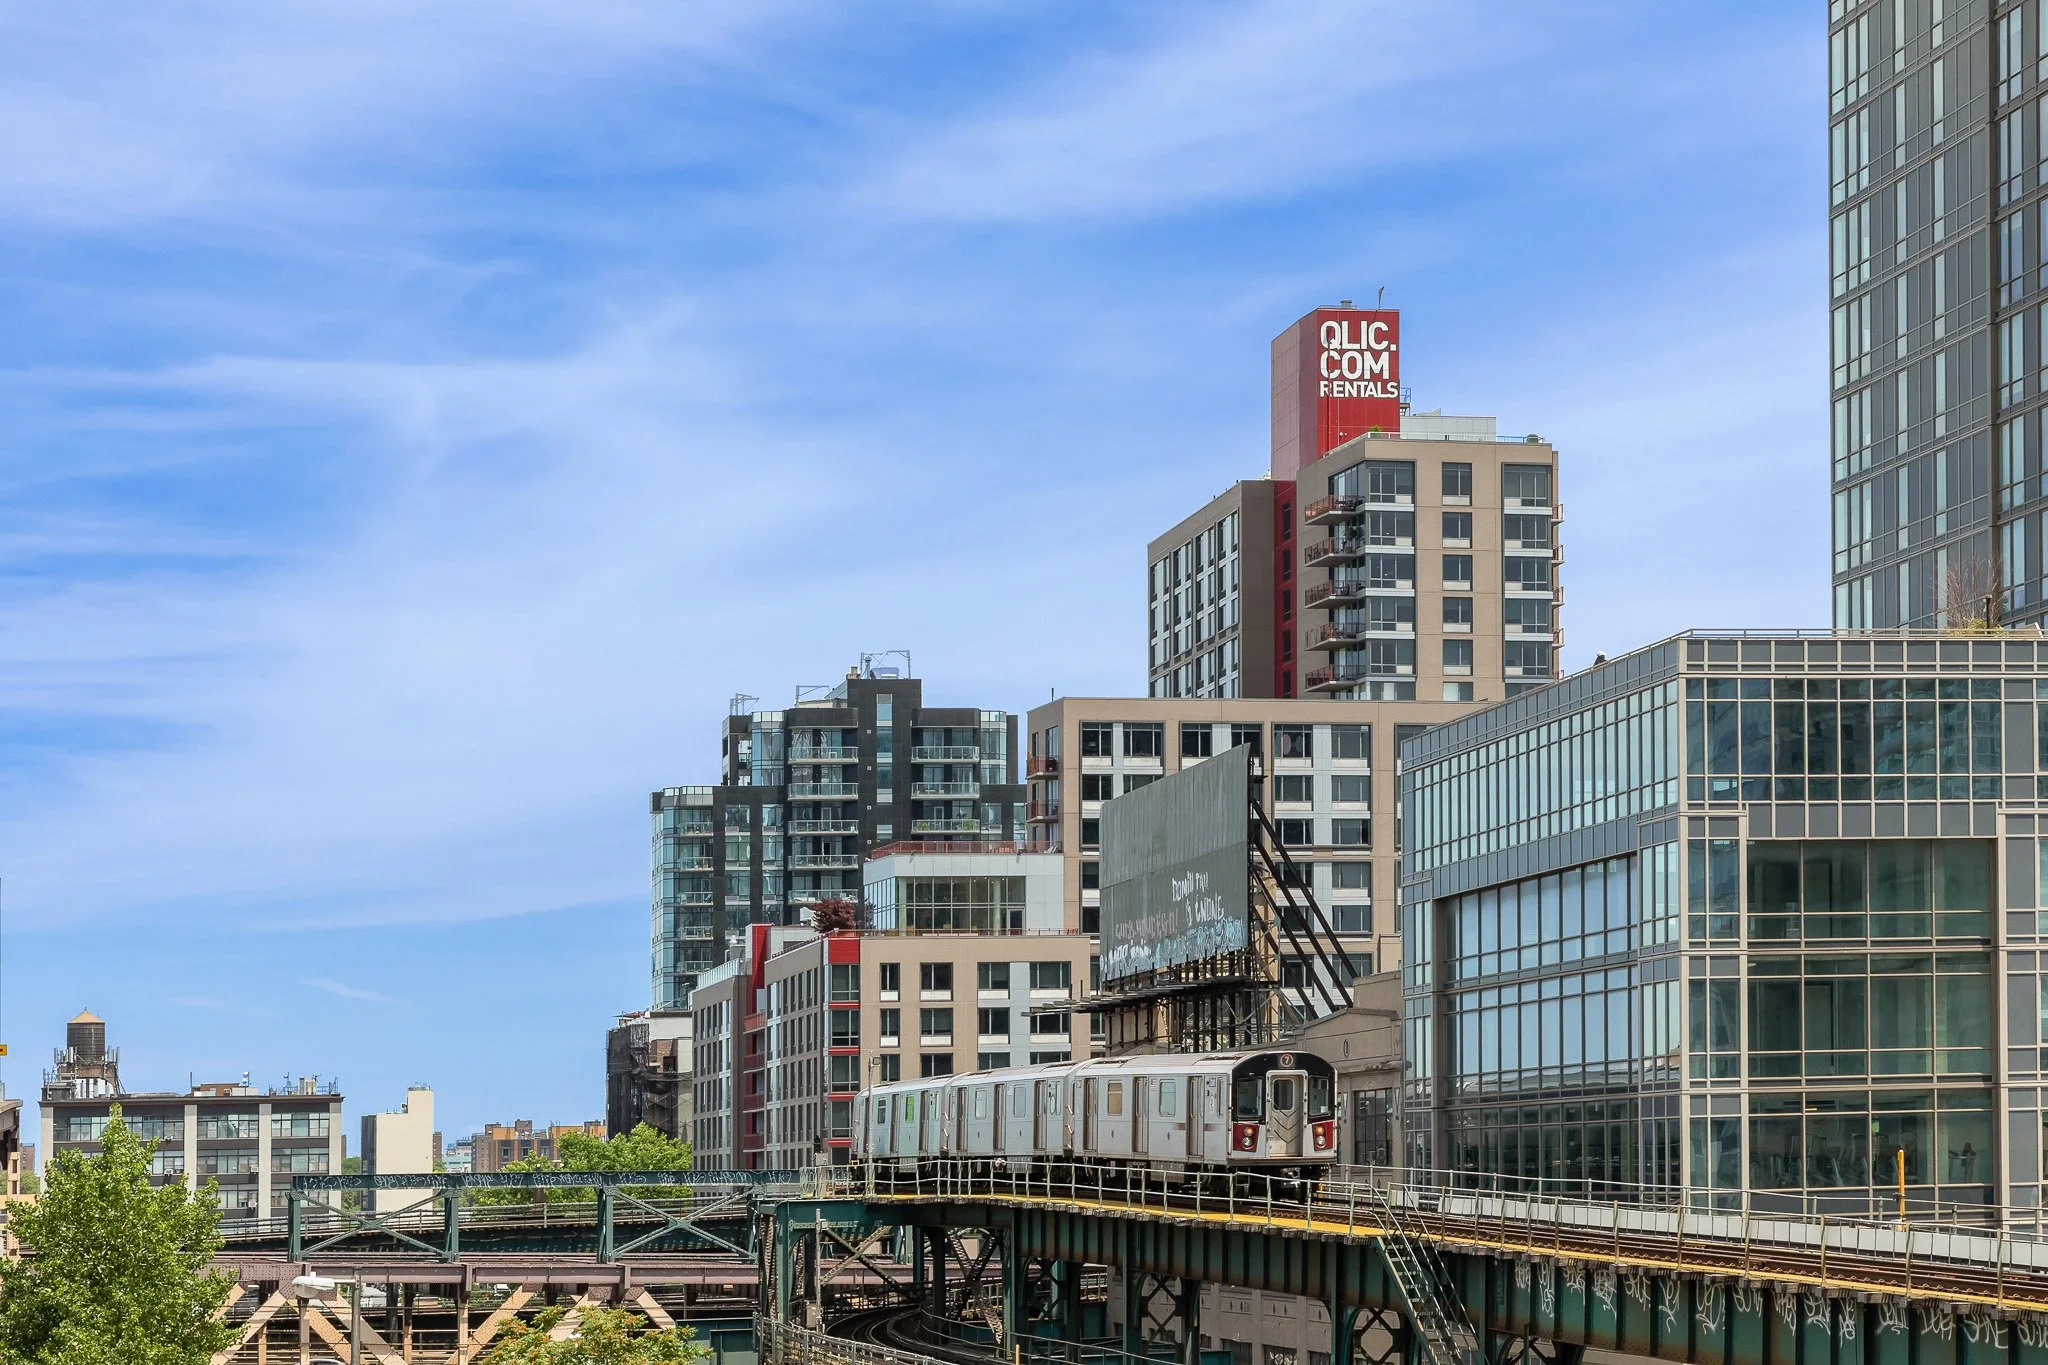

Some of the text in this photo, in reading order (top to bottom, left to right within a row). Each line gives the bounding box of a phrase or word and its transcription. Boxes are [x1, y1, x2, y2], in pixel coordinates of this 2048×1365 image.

[1320, 320, 1397, 351] QLIC.
[1320, 350, 1390, 380] COM
[1320, 380, 1399, 399] RENTALS
